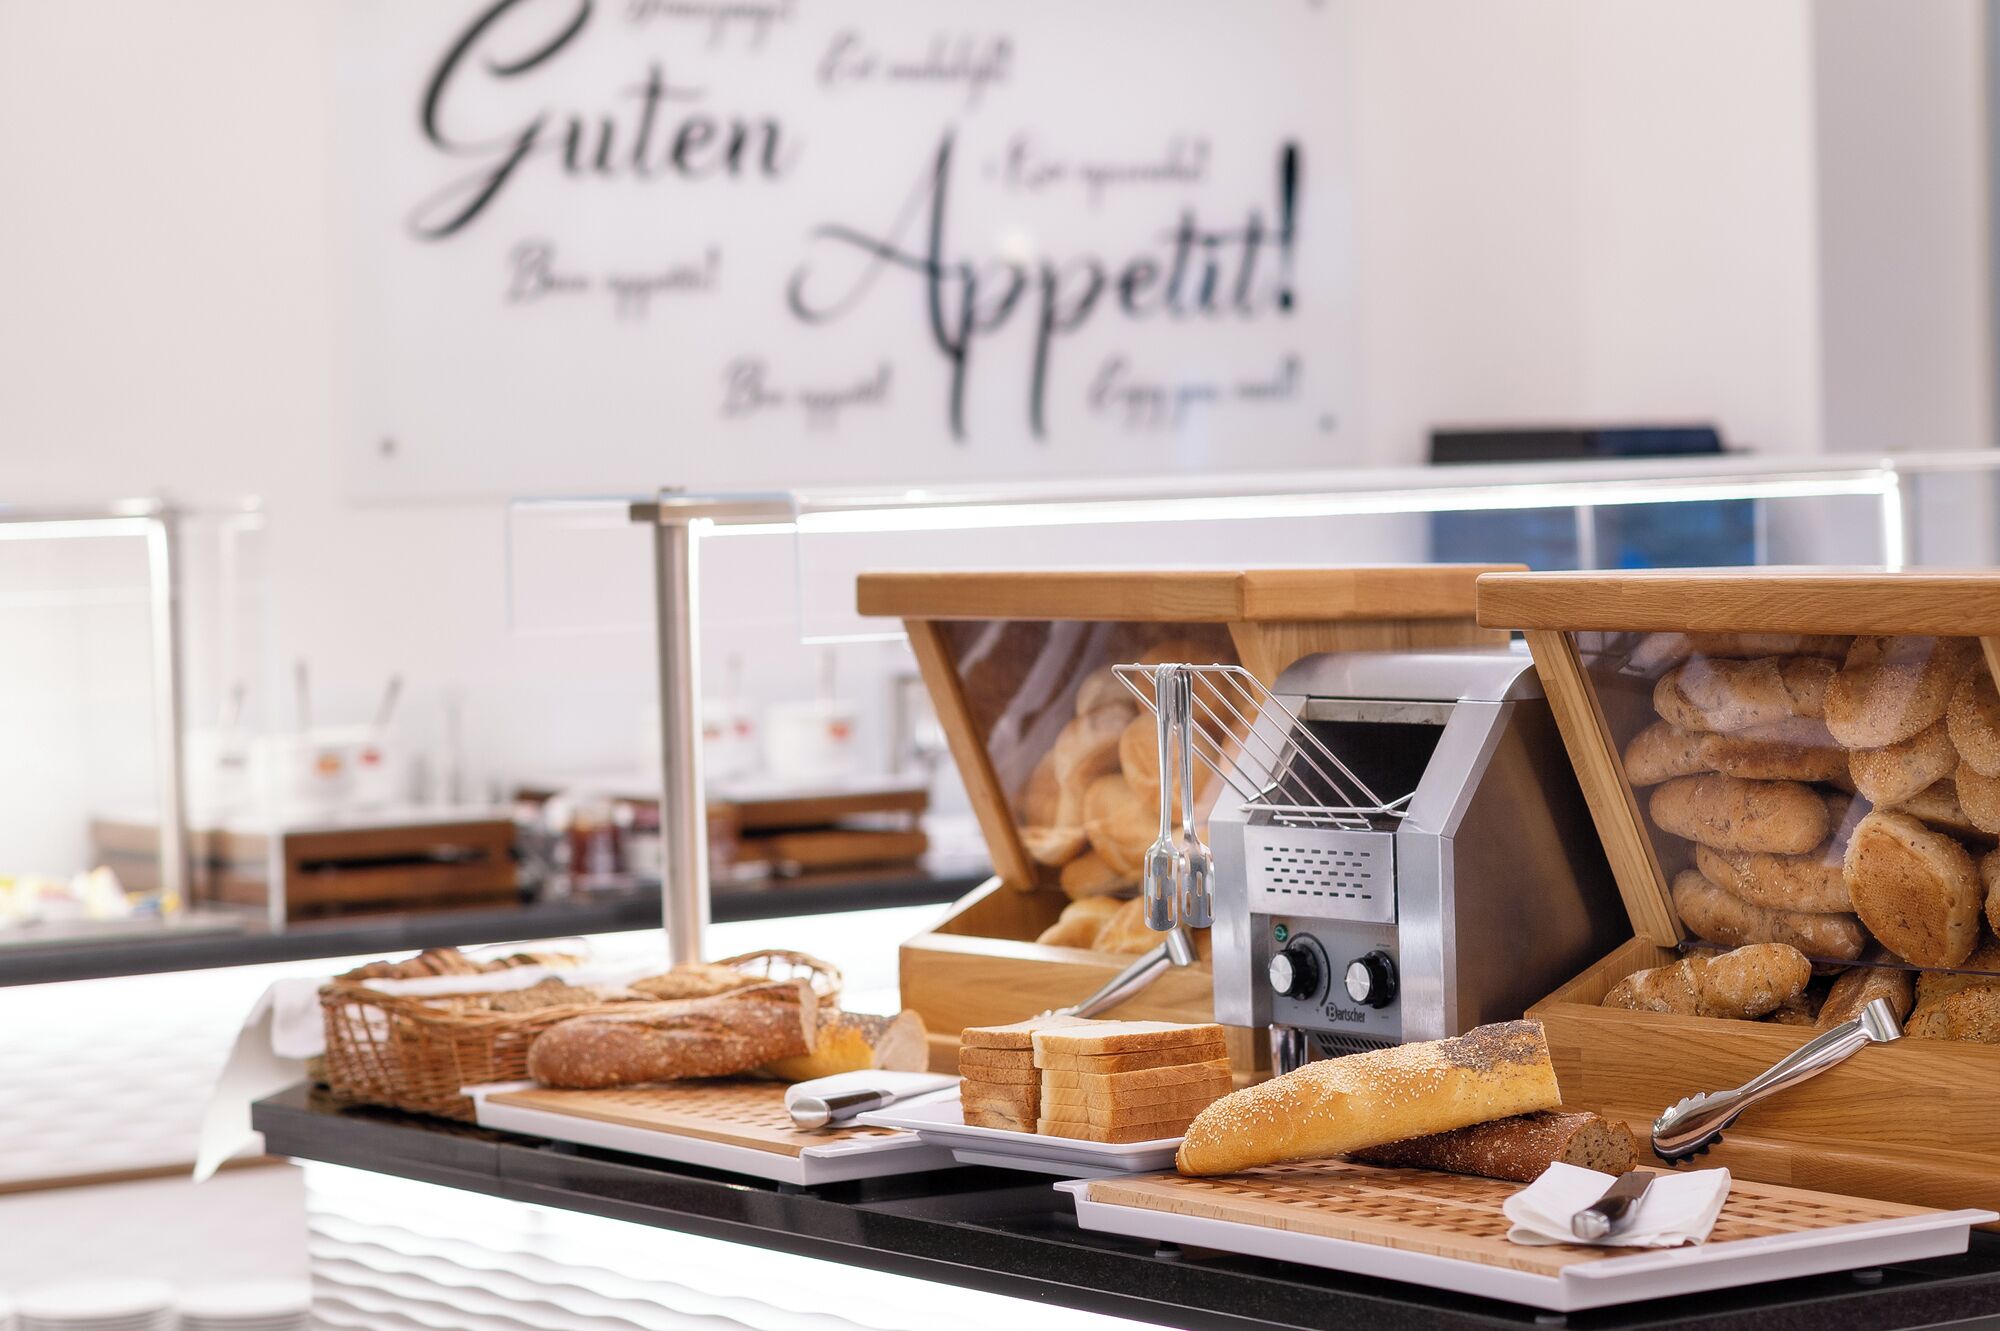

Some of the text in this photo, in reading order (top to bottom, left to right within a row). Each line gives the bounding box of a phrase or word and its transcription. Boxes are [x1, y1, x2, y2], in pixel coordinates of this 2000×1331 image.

[406, 0, 796, 241] Guten
[786, 126, 1303, 443] Appetit!
[1326, 1003, 1365, 1023] Bartscher
